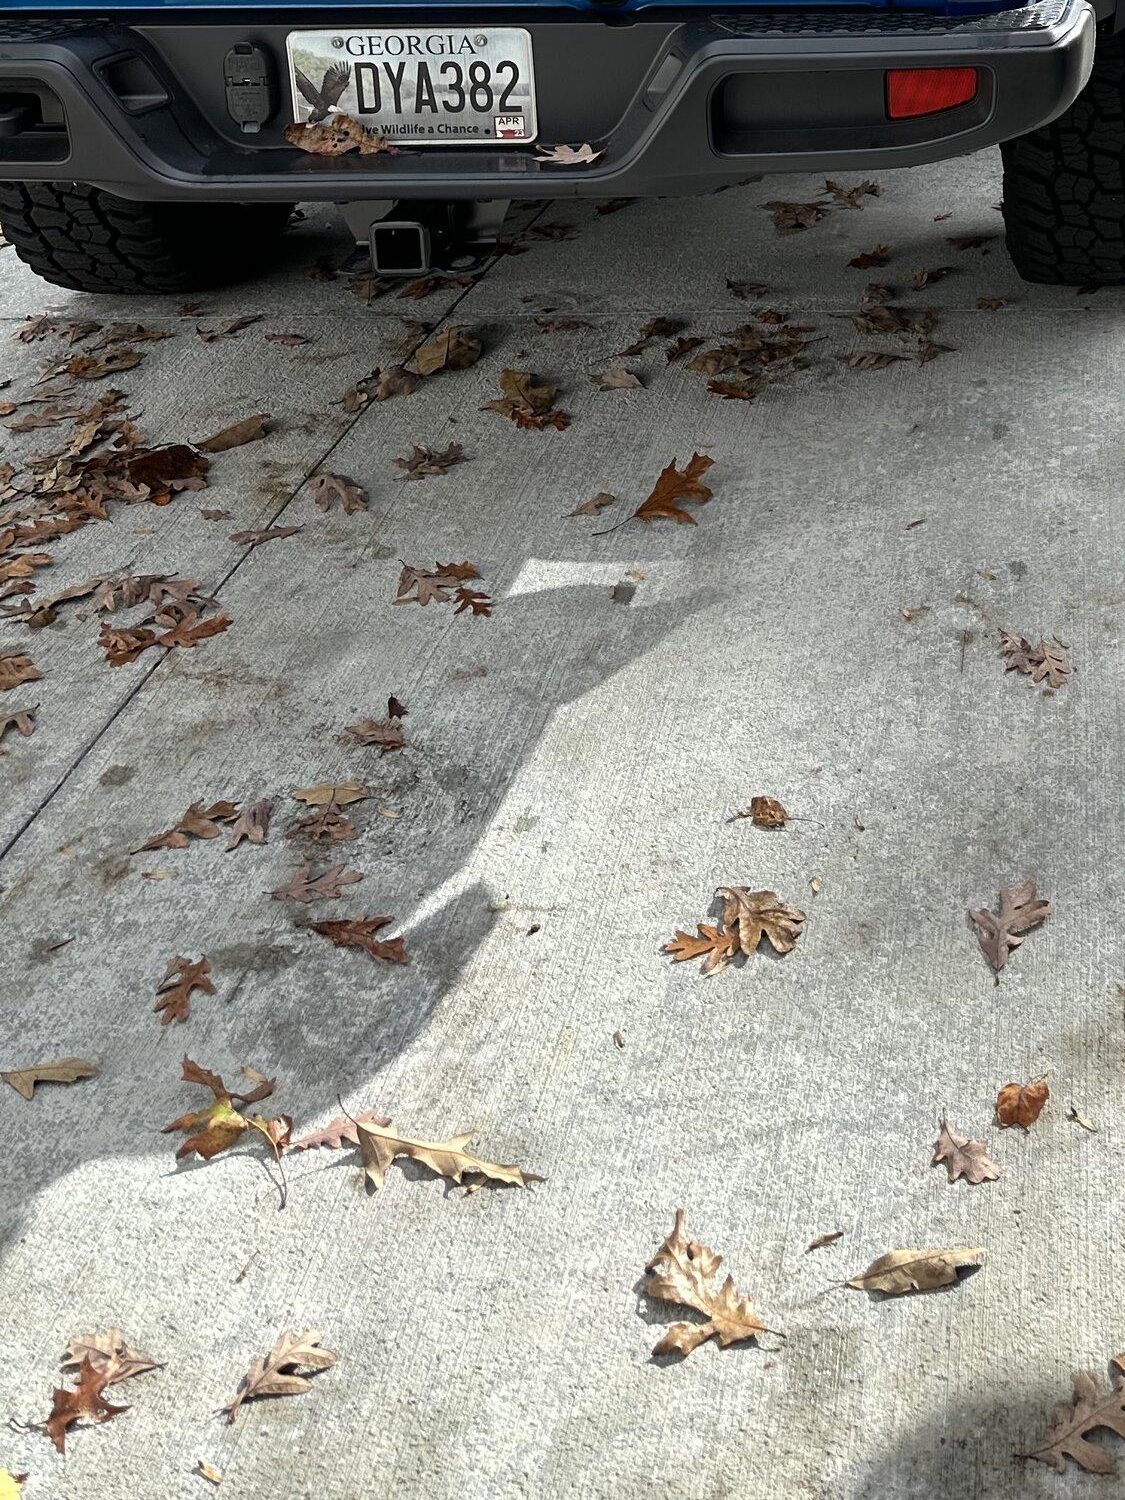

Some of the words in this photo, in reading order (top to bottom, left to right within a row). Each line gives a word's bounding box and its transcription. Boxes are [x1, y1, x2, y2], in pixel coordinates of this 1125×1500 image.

[345, 35, 477, 56] GEORGIA
[354, 60, 523, 114] DYA382
[498, 116, 519, 125] APR
[361, 124, 379, 135] ive
[380, 123, 426, 135] Wildlife
[427, 125, 435, 134] a
[437, 123, 479, 134] Chance
